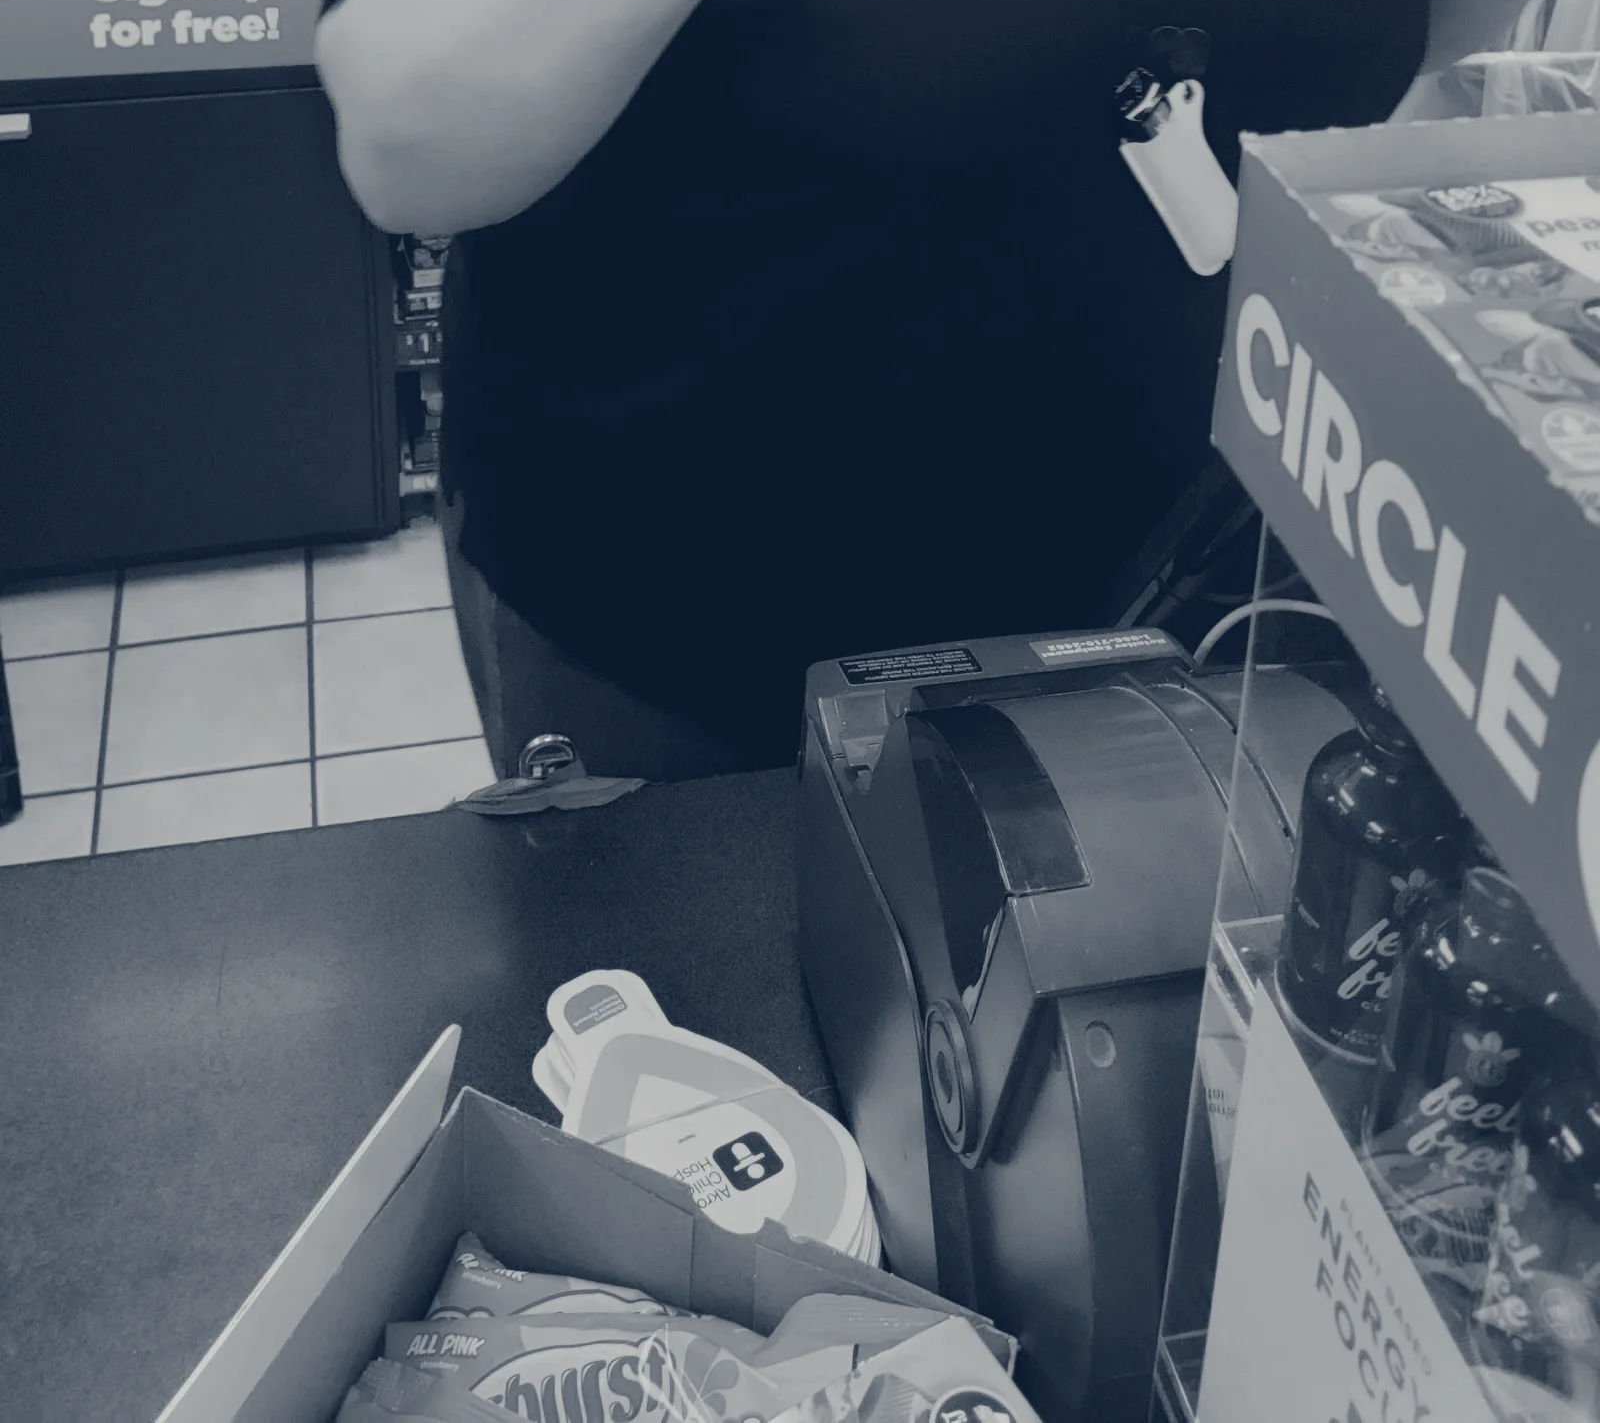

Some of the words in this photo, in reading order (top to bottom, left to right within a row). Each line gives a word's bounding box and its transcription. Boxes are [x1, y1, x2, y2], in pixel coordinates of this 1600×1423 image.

[90, 13, 162, 48] for
[171, 7, 280, 44] free!
[1236, 293, 1562, 806] CIRCLE
[673, 1156, 714, 1182] Hosp
[696, 1185, 731, 1210] Akro
[407, 1334, 438, 1357] ALL
[441, 1335, 485, 1357] PINK
